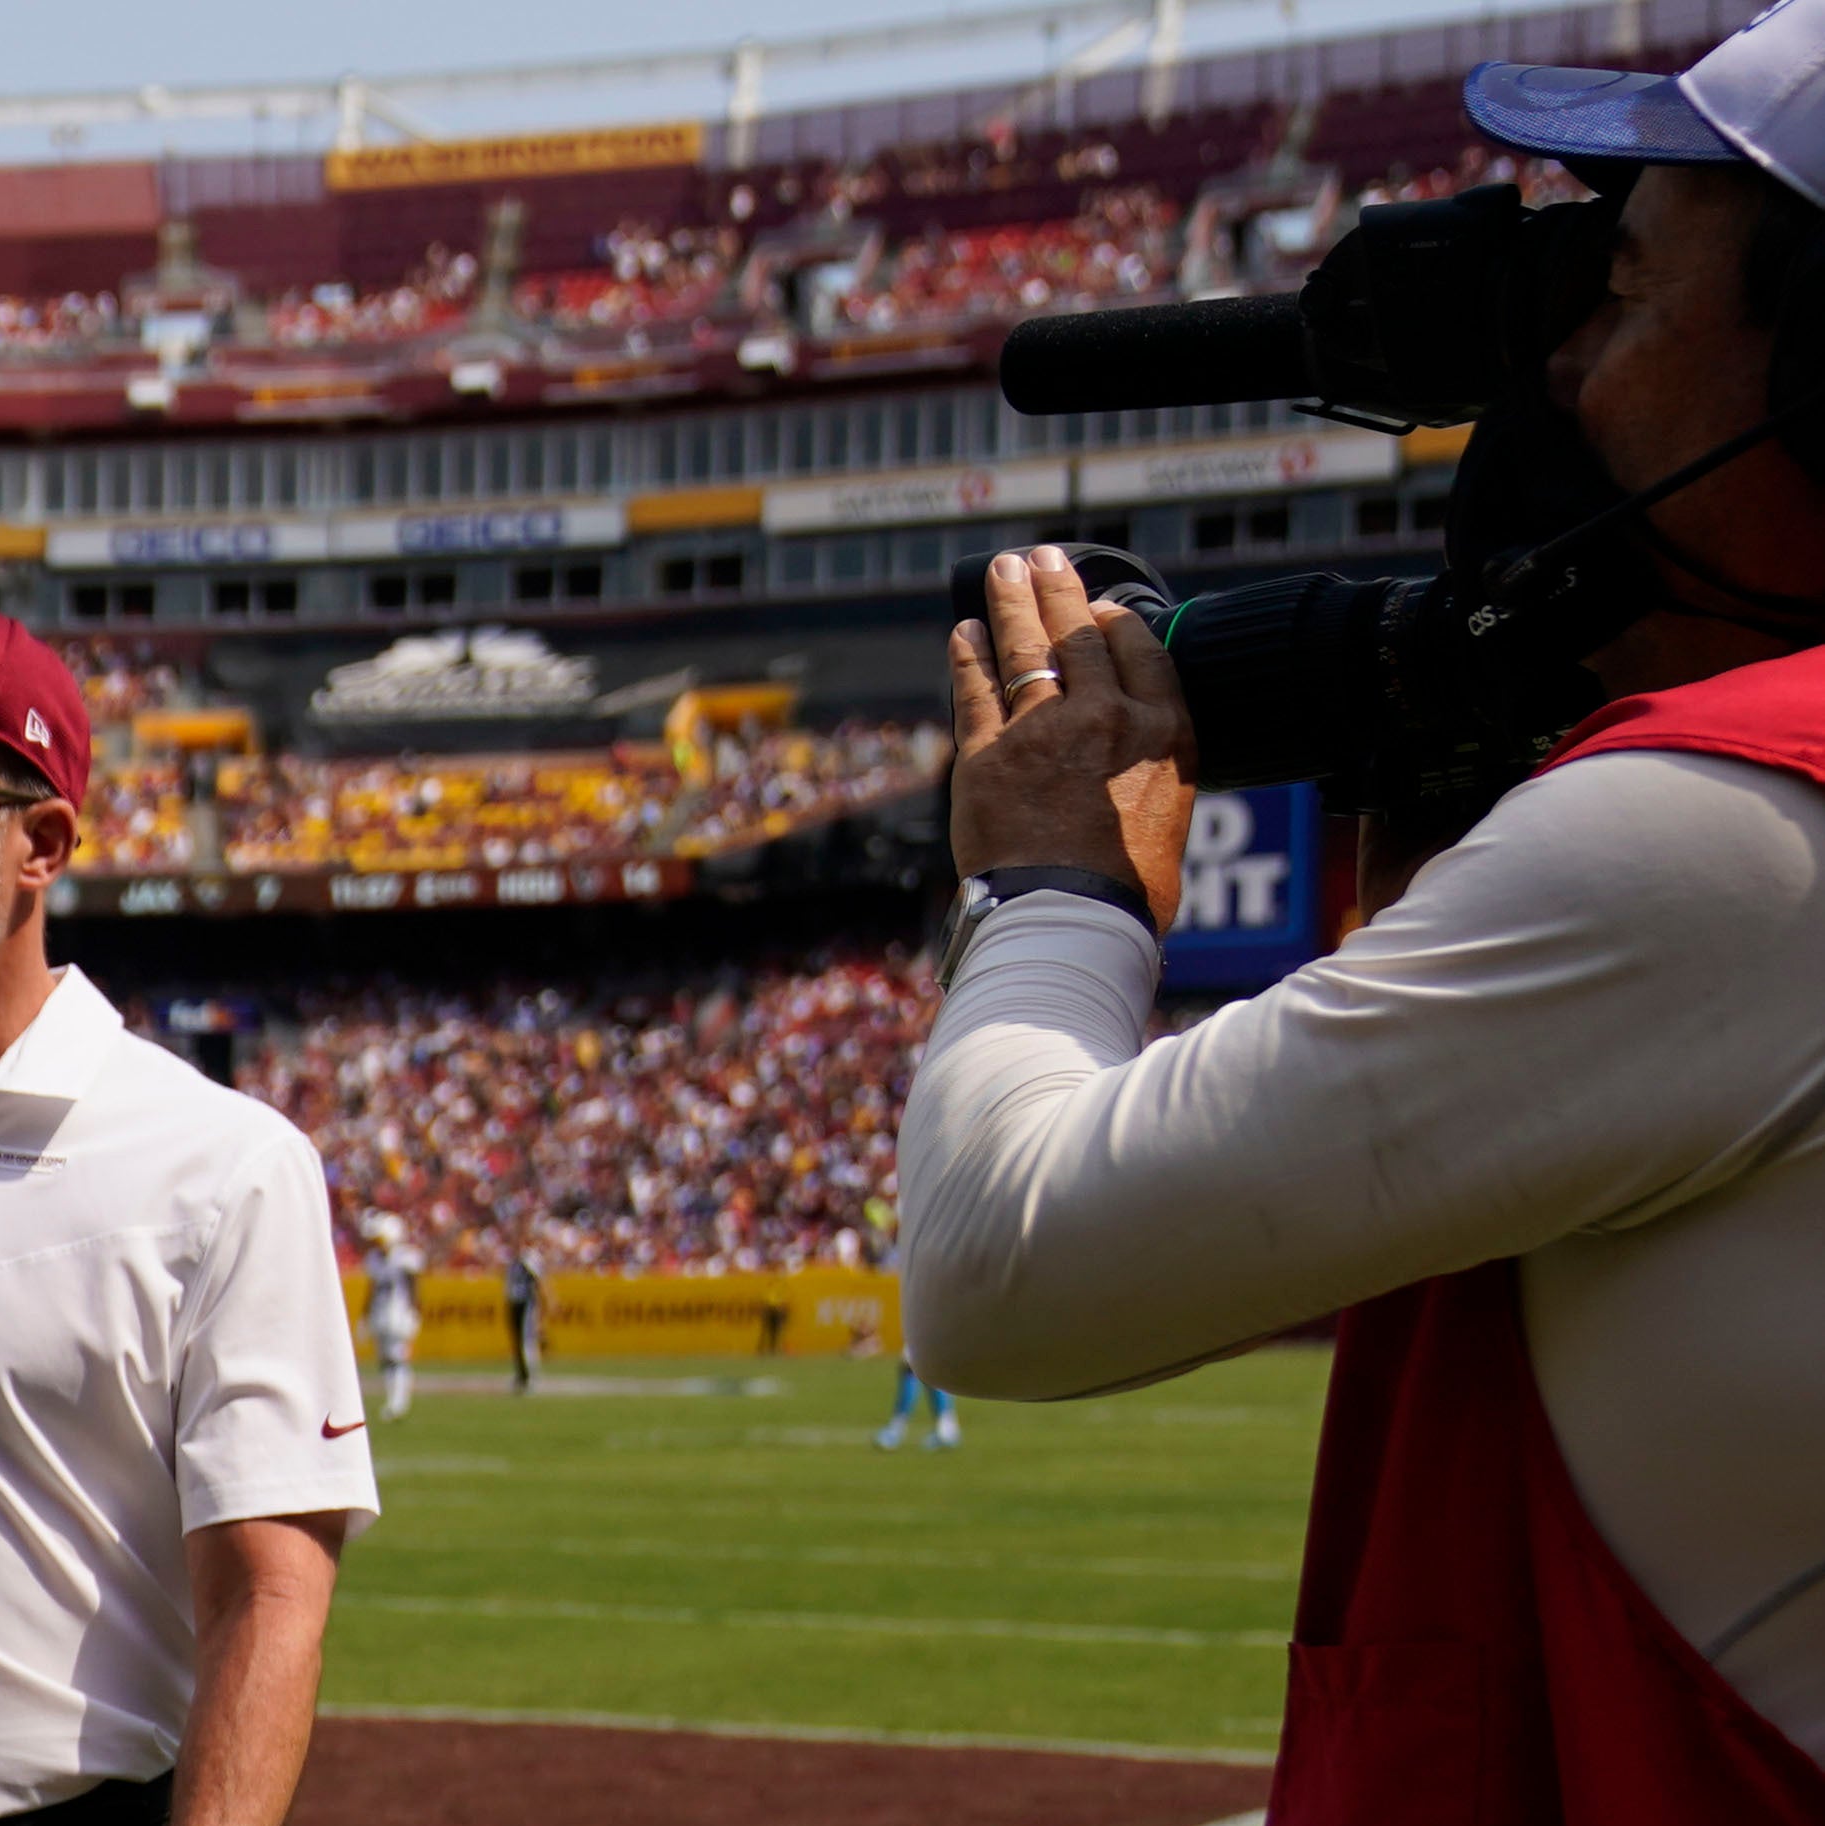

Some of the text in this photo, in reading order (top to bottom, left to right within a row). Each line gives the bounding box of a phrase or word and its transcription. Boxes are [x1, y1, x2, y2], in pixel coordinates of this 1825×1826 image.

[111, 524, 271, 566] GEICO
[397, 508, 563, 554] GEICO
[1186, 793, 1255, 862] D
[604, 1302, 784, 1328] CHAMPION
